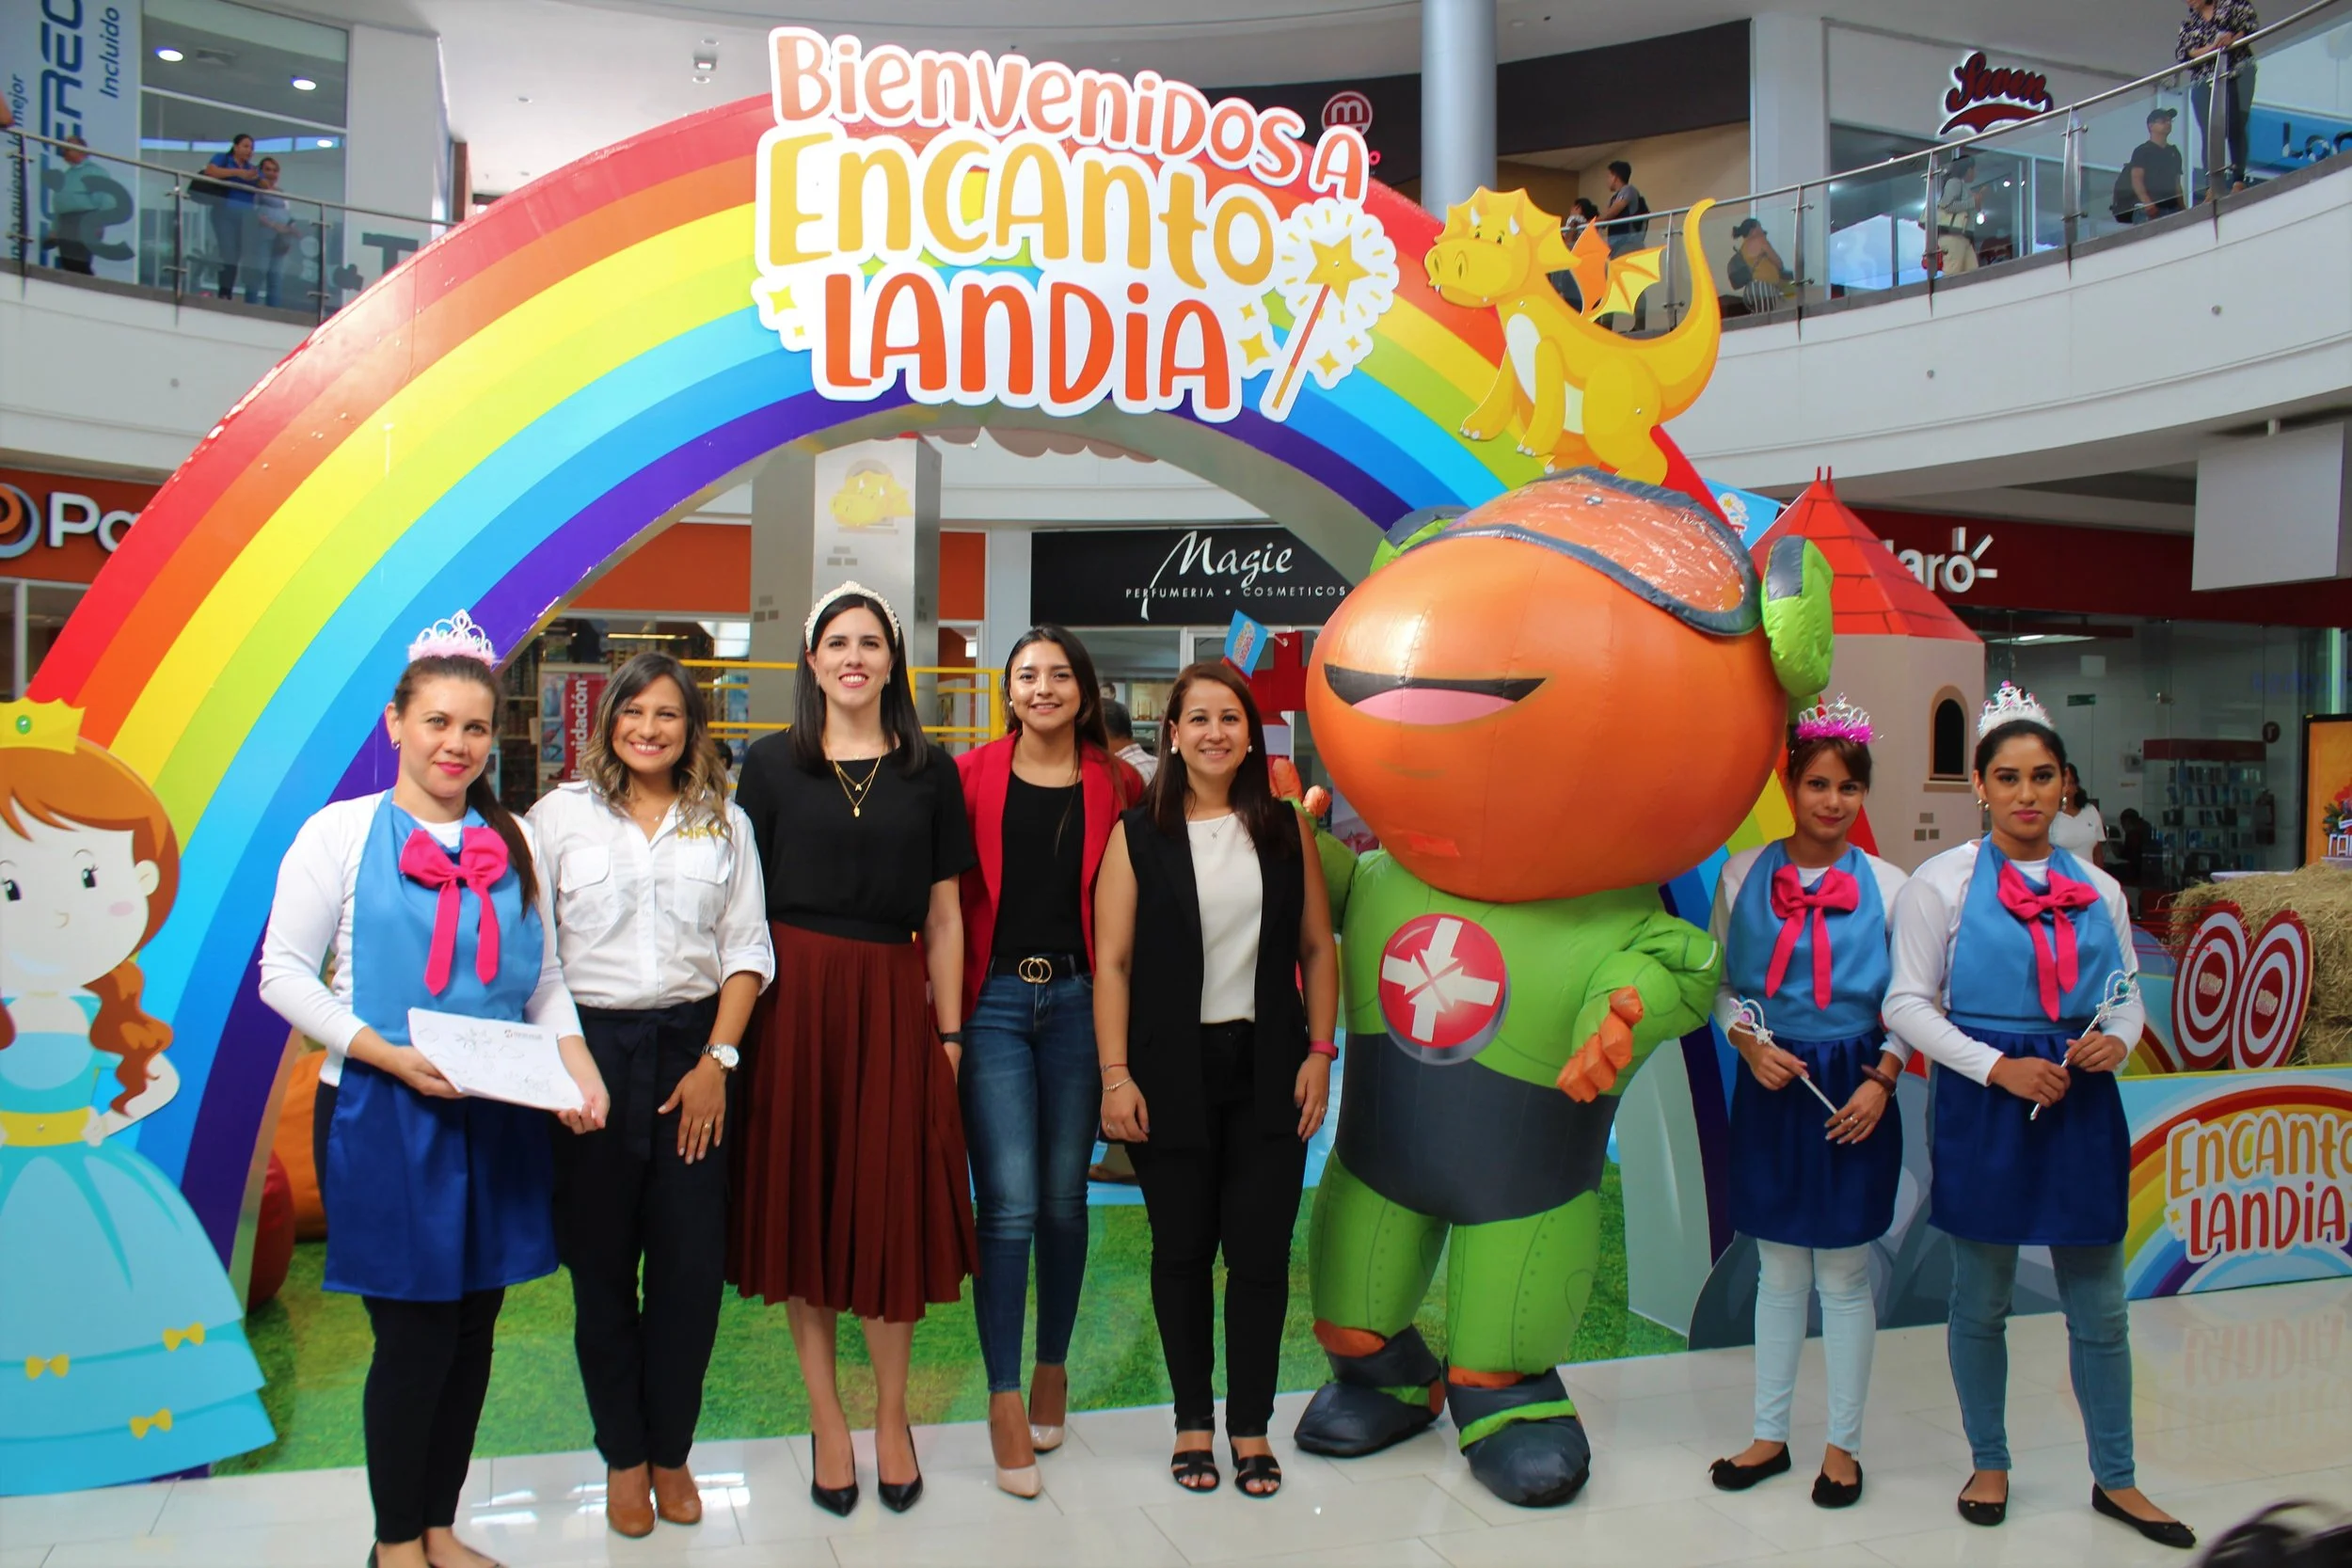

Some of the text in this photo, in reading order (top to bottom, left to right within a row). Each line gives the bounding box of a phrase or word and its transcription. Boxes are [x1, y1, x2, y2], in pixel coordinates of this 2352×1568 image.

[99, 7, 119, 99] Incluido
[1315, 133, 1362, 200] A
[1125, 586, 1345, 598] PERFUMERIA COSMETICOS
[1141, 531, 1293, 621] Magie
